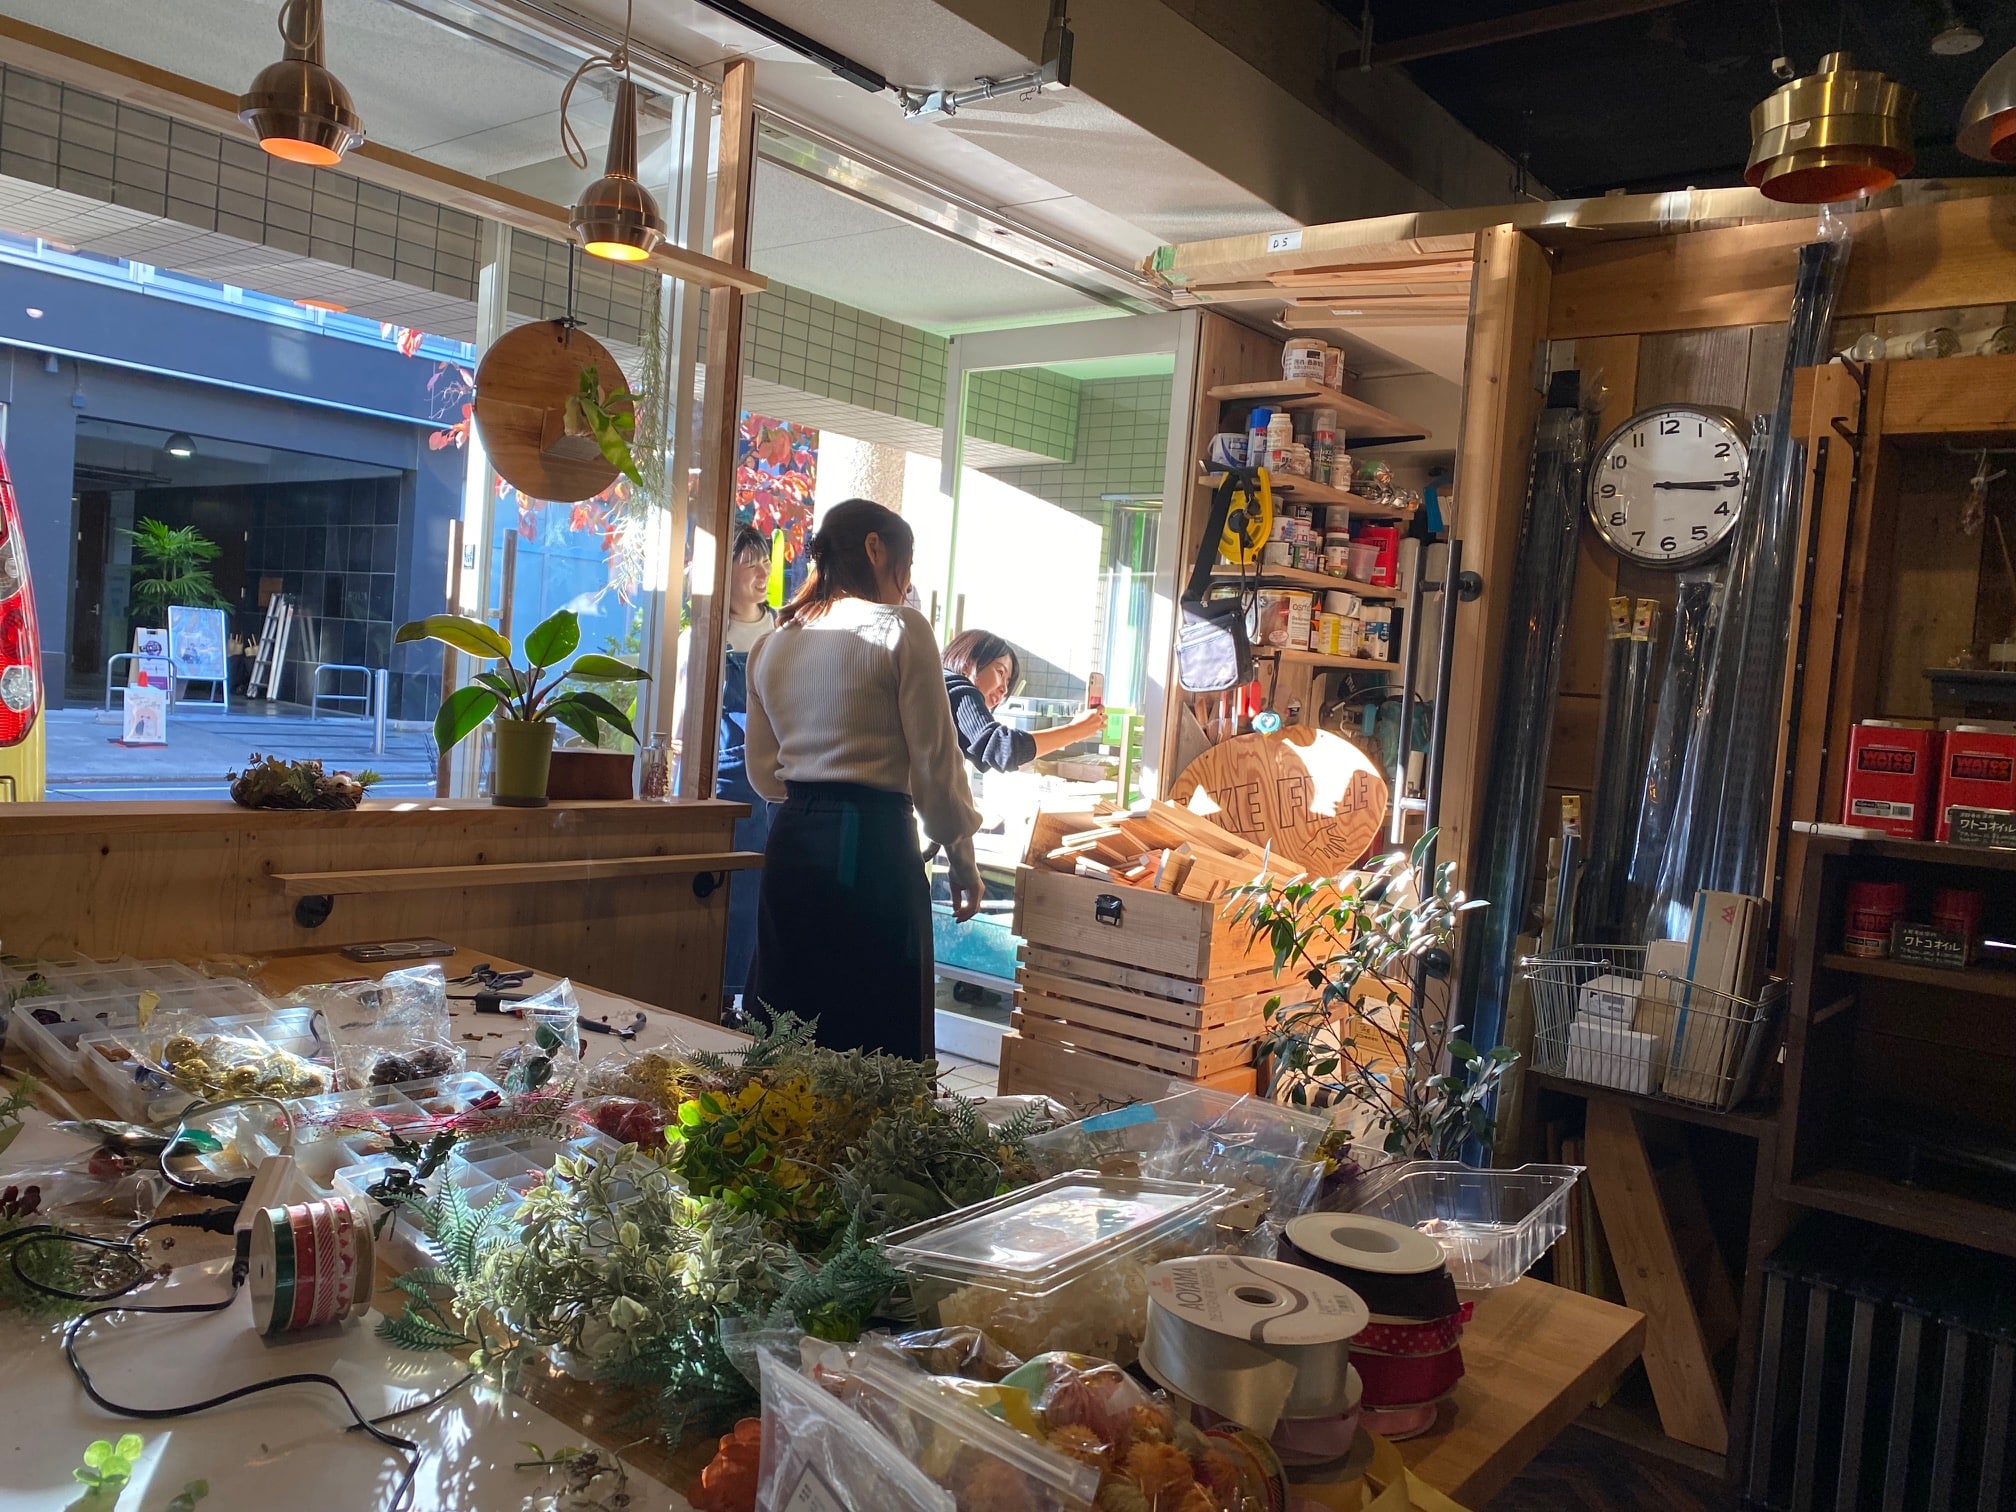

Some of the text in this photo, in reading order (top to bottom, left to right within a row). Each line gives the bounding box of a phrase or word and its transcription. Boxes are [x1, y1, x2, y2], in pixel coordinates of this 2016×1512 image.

[1660, 419, 1680, 435] 12
[1698, 423, 1703, 437] 1
[1633, 433, 1644, 448] 11
[1714, 443, 1731, 458] 2
[1611, 455, 1627, 470] 10
[1723, 472, 1740, 487] 3
[1600, 485, 1616, 499] 9
[1713, 502, 1730, 516] 4
[1610, 512, 1626, 526] 8
[1631, 531, 1646, 546] 7
[1691, 526, 1708, 540] 5
[1660, 536, 1677, 551] 6
[1960, 818, 2016, 833] ワトコオイル
[1904, 936, 1961, 951] ワトコオイル
[1174, 1268, 1204, 1311] AOYAMA
